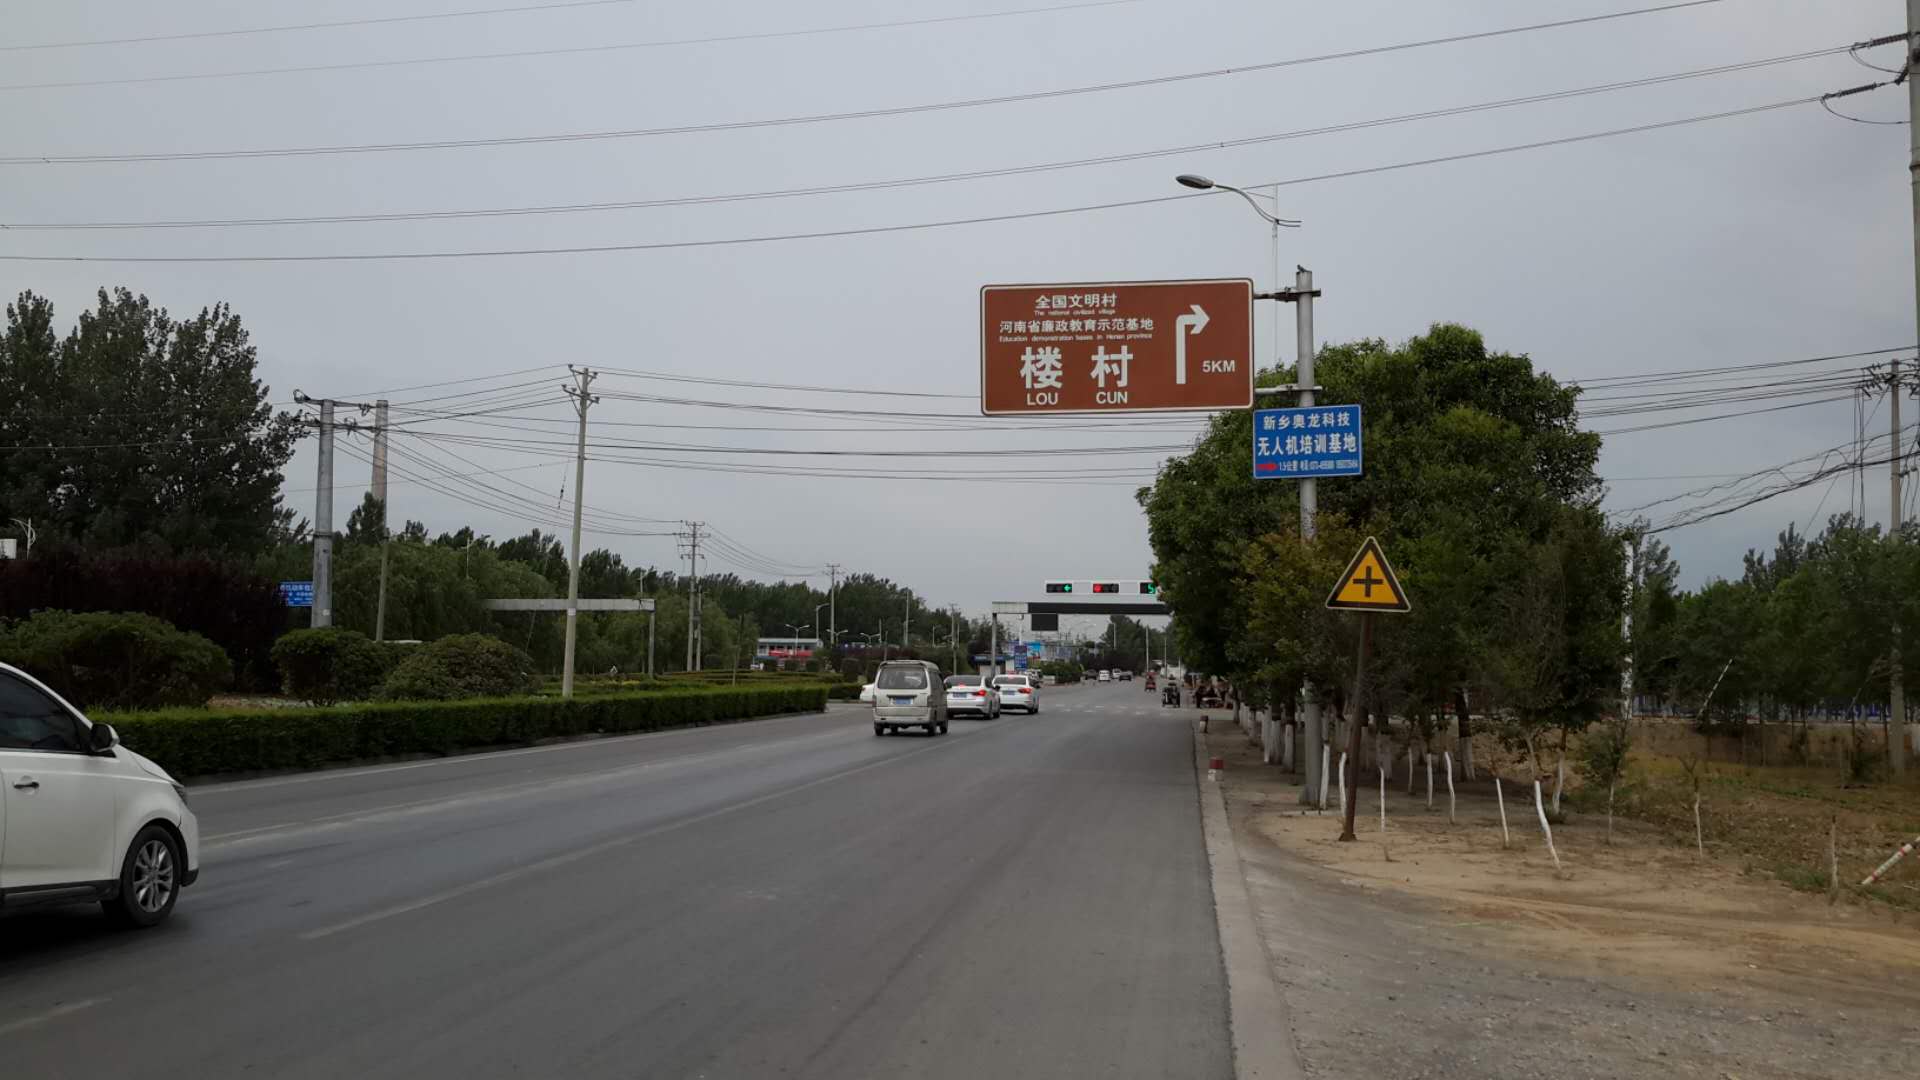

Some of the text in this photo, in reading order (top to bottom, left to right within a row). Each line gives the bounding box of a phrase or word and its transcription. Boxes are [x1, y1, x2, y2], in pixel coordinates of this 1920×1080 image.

[1035, 292, 1117, 309] 全国文明村
[1000, 318, 1154, 333] 河南省廉政教育示范基地
[1127, 333, 1152, 341] province
[1020, 345, 1133, 389] 楼 村
[1202, 360, 1235, 373] 5KM
[1027, 391, 1350, 430] LOU CUN 新乡奥龙科技
[1258, 433, 1357, 456] 无人机培训基地
